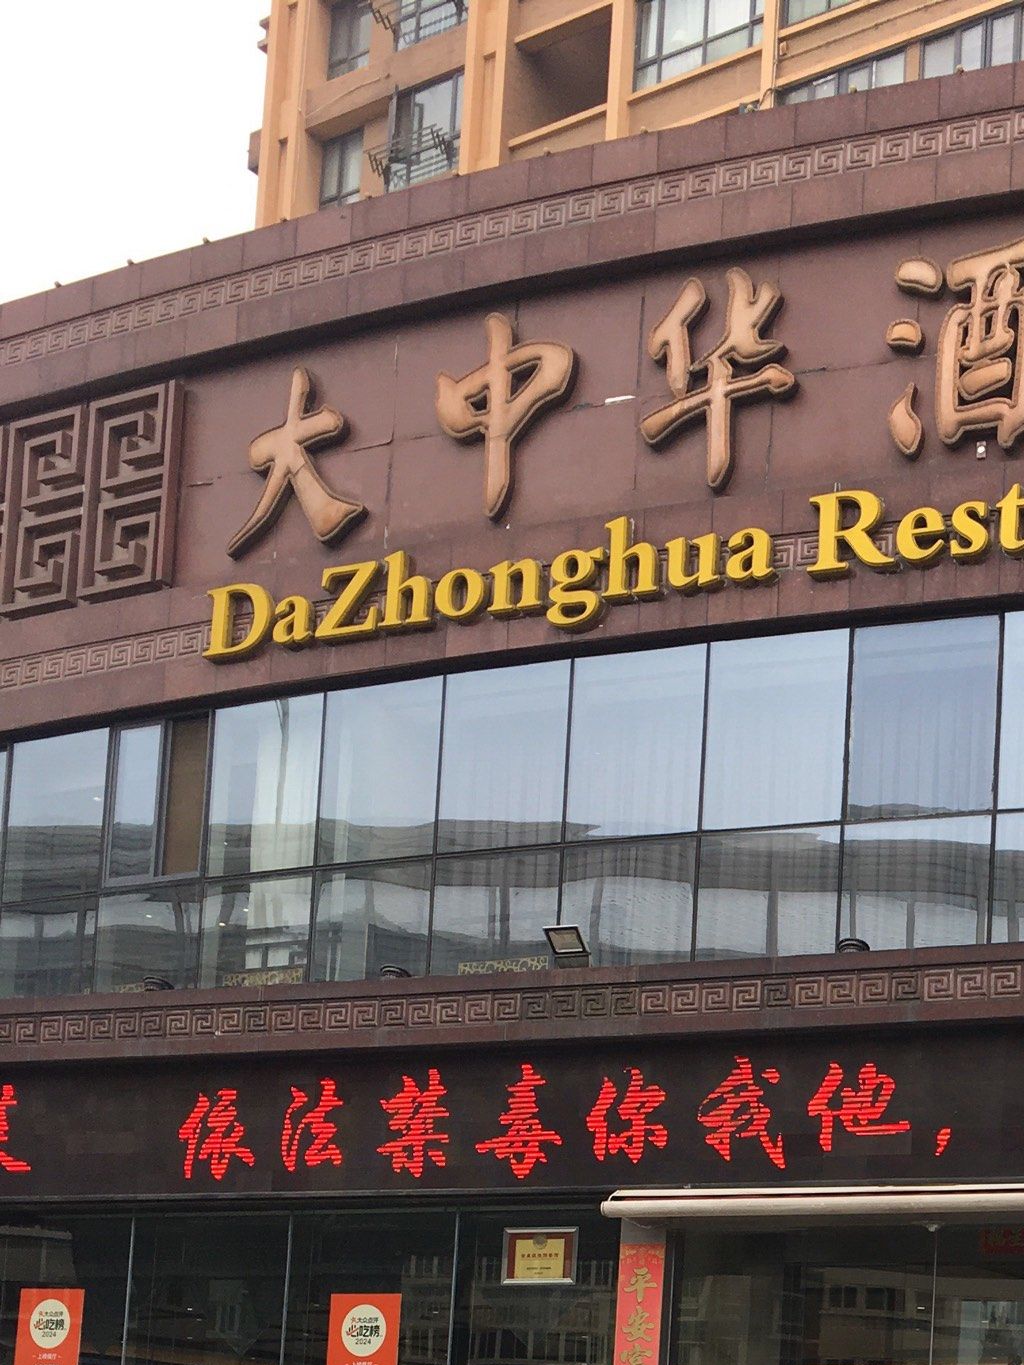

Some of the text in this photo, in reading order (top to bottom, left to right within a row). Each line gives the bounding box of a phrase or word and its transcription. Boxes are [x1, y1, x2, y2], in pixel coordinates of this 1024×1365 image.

[202, 515, 777, 664] DaZhonghua
[345, 1324, 380, 1338] 必吃榜
